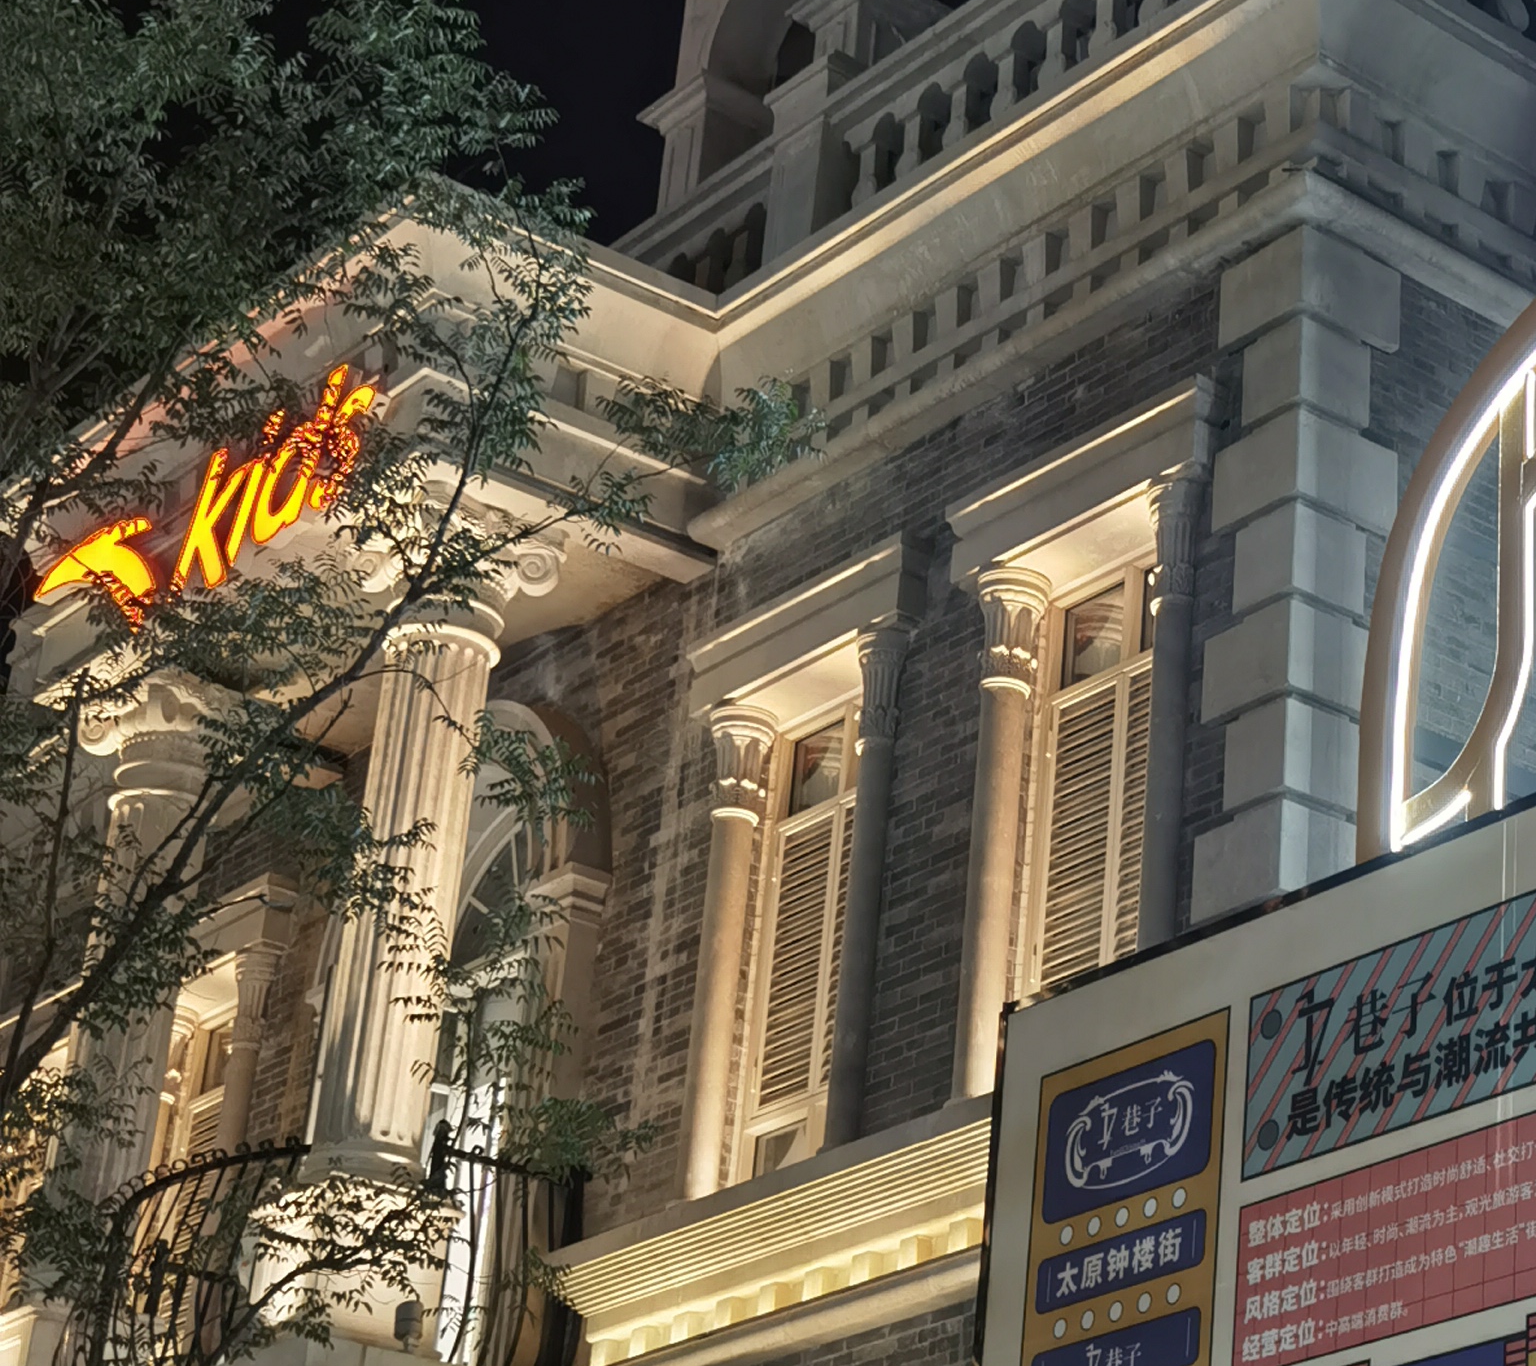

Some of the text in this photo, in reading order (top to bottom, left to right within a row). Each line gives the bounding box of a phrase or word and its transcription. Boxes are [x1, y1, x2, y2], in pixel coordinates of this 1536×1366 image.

[1056, 1227, 1183, 1298] 太原钟楼街
